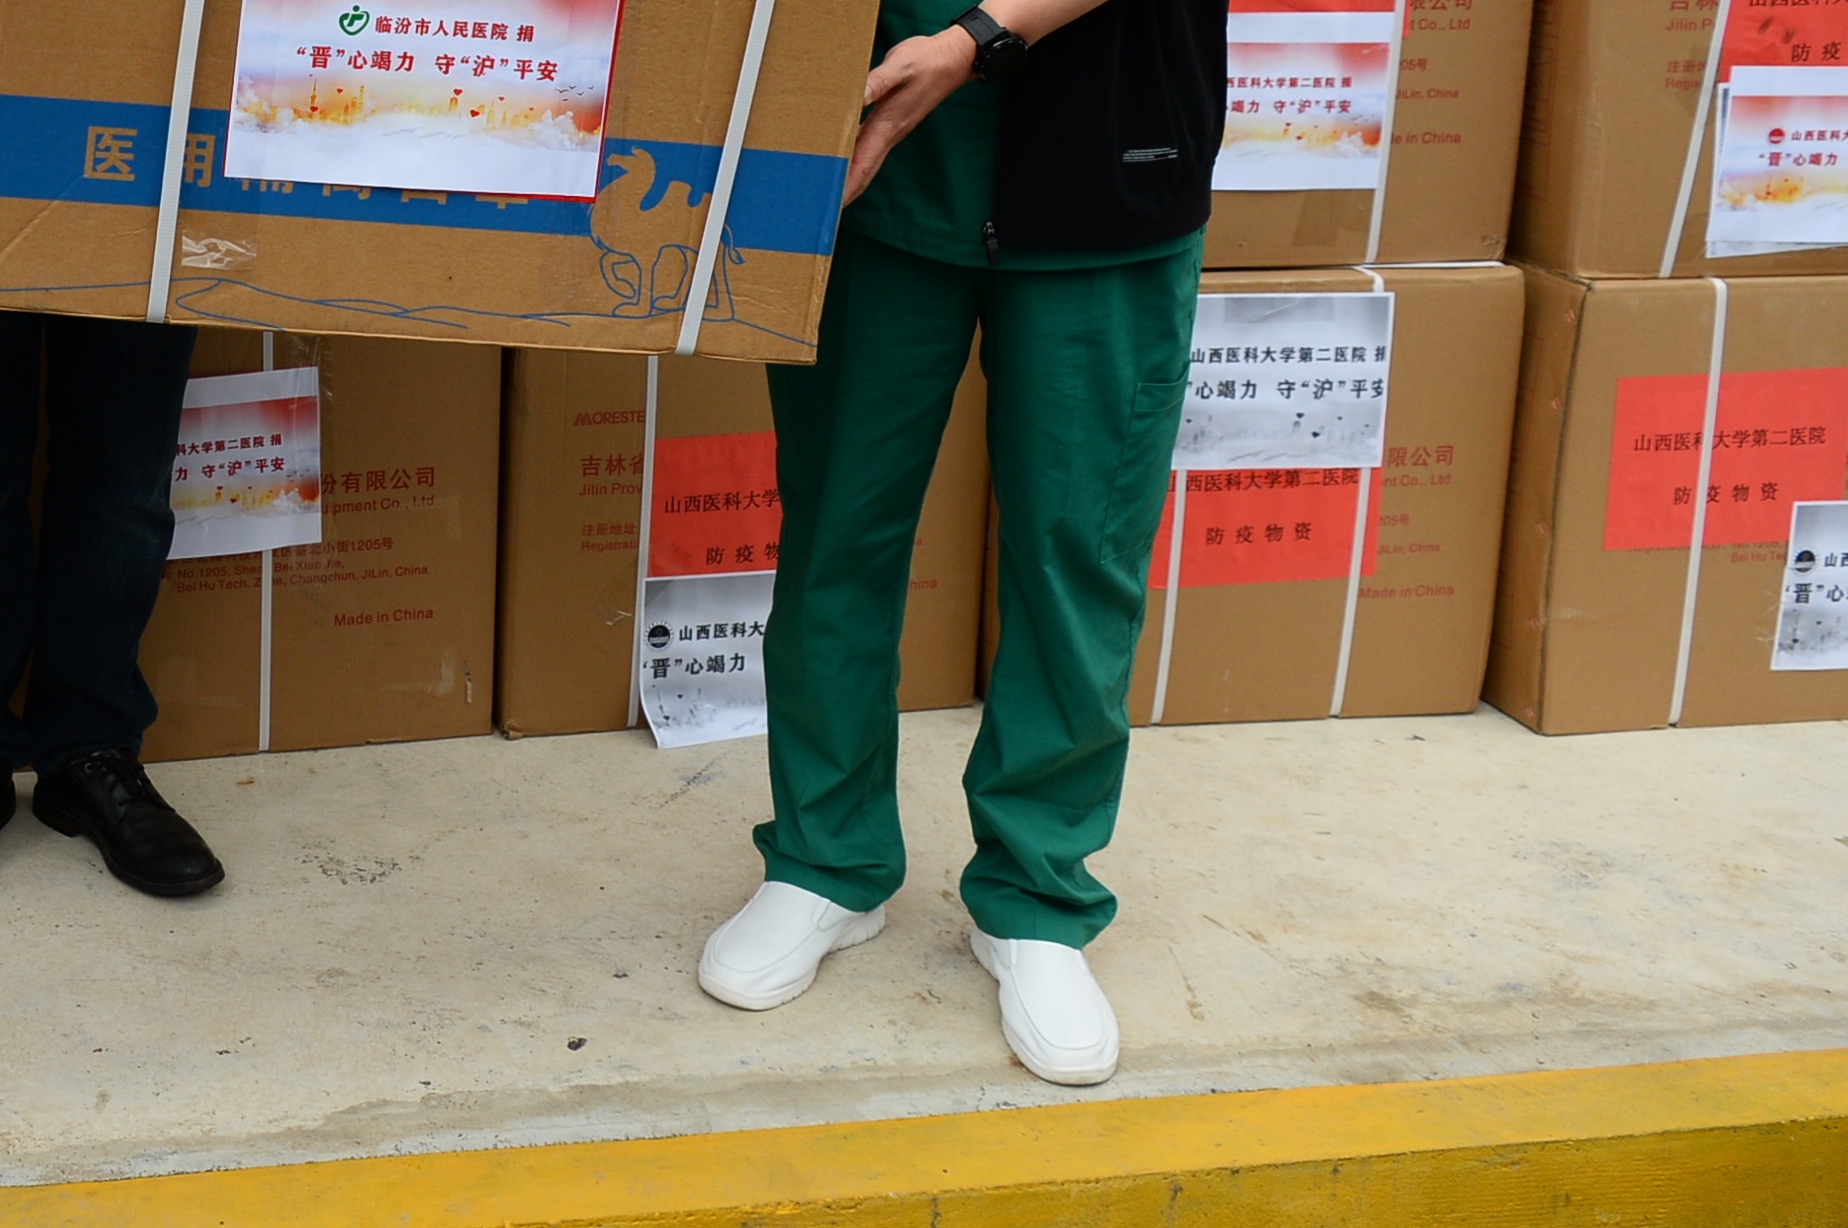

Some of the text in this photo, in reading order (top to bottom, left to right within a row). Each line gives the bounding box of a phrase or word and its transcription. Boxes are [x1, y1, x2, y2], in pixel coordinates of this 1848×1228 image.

[374, 16, 535, 42] 临汾市人民医院 捐
[1449, 17, 1471, 30] Ltd
[1666, 19, 1698, 32] Jilin
[1790, 41, 1842, 63] 防疫
[296, 45, 559, 82] “晋”心竭力 守“沪”平安
[1427, 88, 1460, 100] China
[1406, 131, 1462, 145] in China
[1190, 346, 1368, 364] 山西医科大学第二医院
[1430, 473, 1452, 486] Ltd
[579, 483, 608, 497] Jilin
[664, 488, 780, 514] 山西医科大学
[581, 522, 637, 537] 注册地址
[1205, 522, 1313, 546] 防疫物资
[706, 541, 779, 566] 防疫物
[1409, 542, 1442, 555] China
[176, 581, 197, 594] Bei
[198, 580, 216, 592] Hu
[218, 578, 252, 590] Tech.
[361, 567, 393, 581] JiLin,
[395, 565, 429, 576] China
[1358, 586, 1397, 600] Made
[1415, 584, 1455, 598] China
[333, 607, 435, 627] Made in China
[679, 621, 764, 642] 山西医科大
